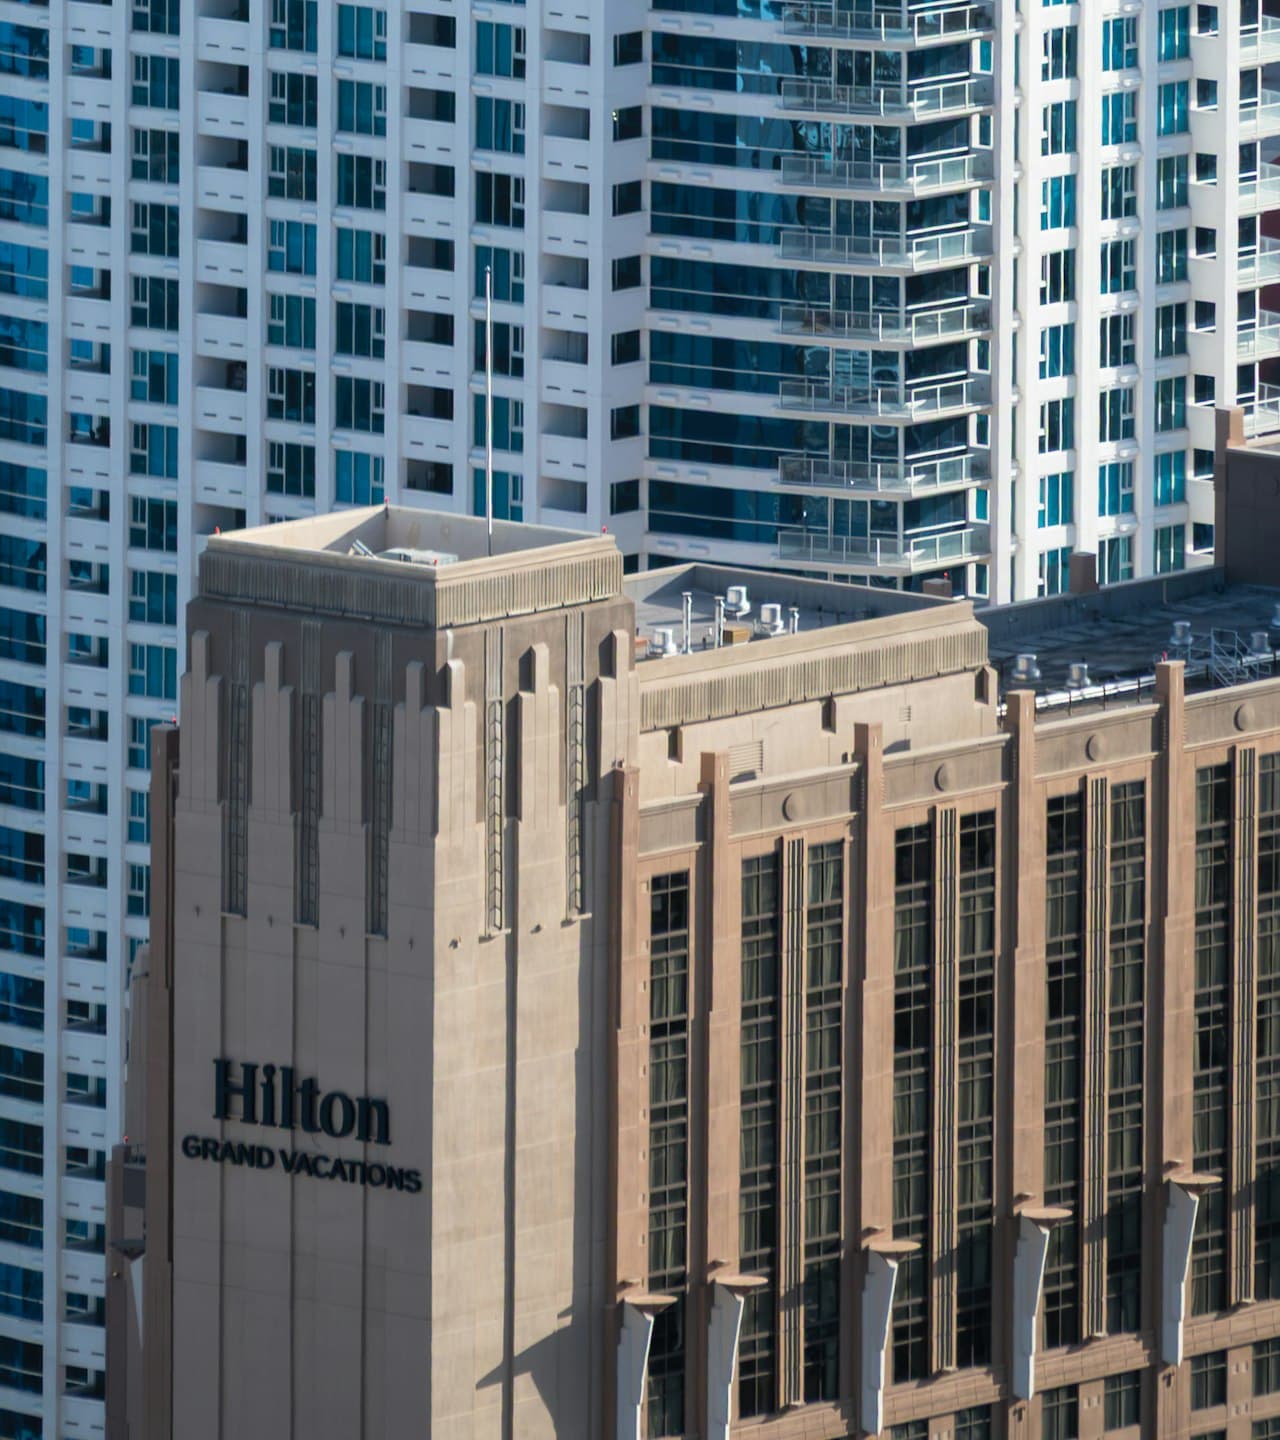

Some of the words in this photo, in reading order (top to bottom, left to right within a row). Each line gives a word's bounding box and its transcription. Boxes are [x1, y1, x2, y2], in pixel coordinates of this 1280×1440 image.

[213, 1058, 392, 1146] Hilton
[182, 1135, 276, 1170] GRAND
[278, 1148, 423, 1194] VACATIONS
